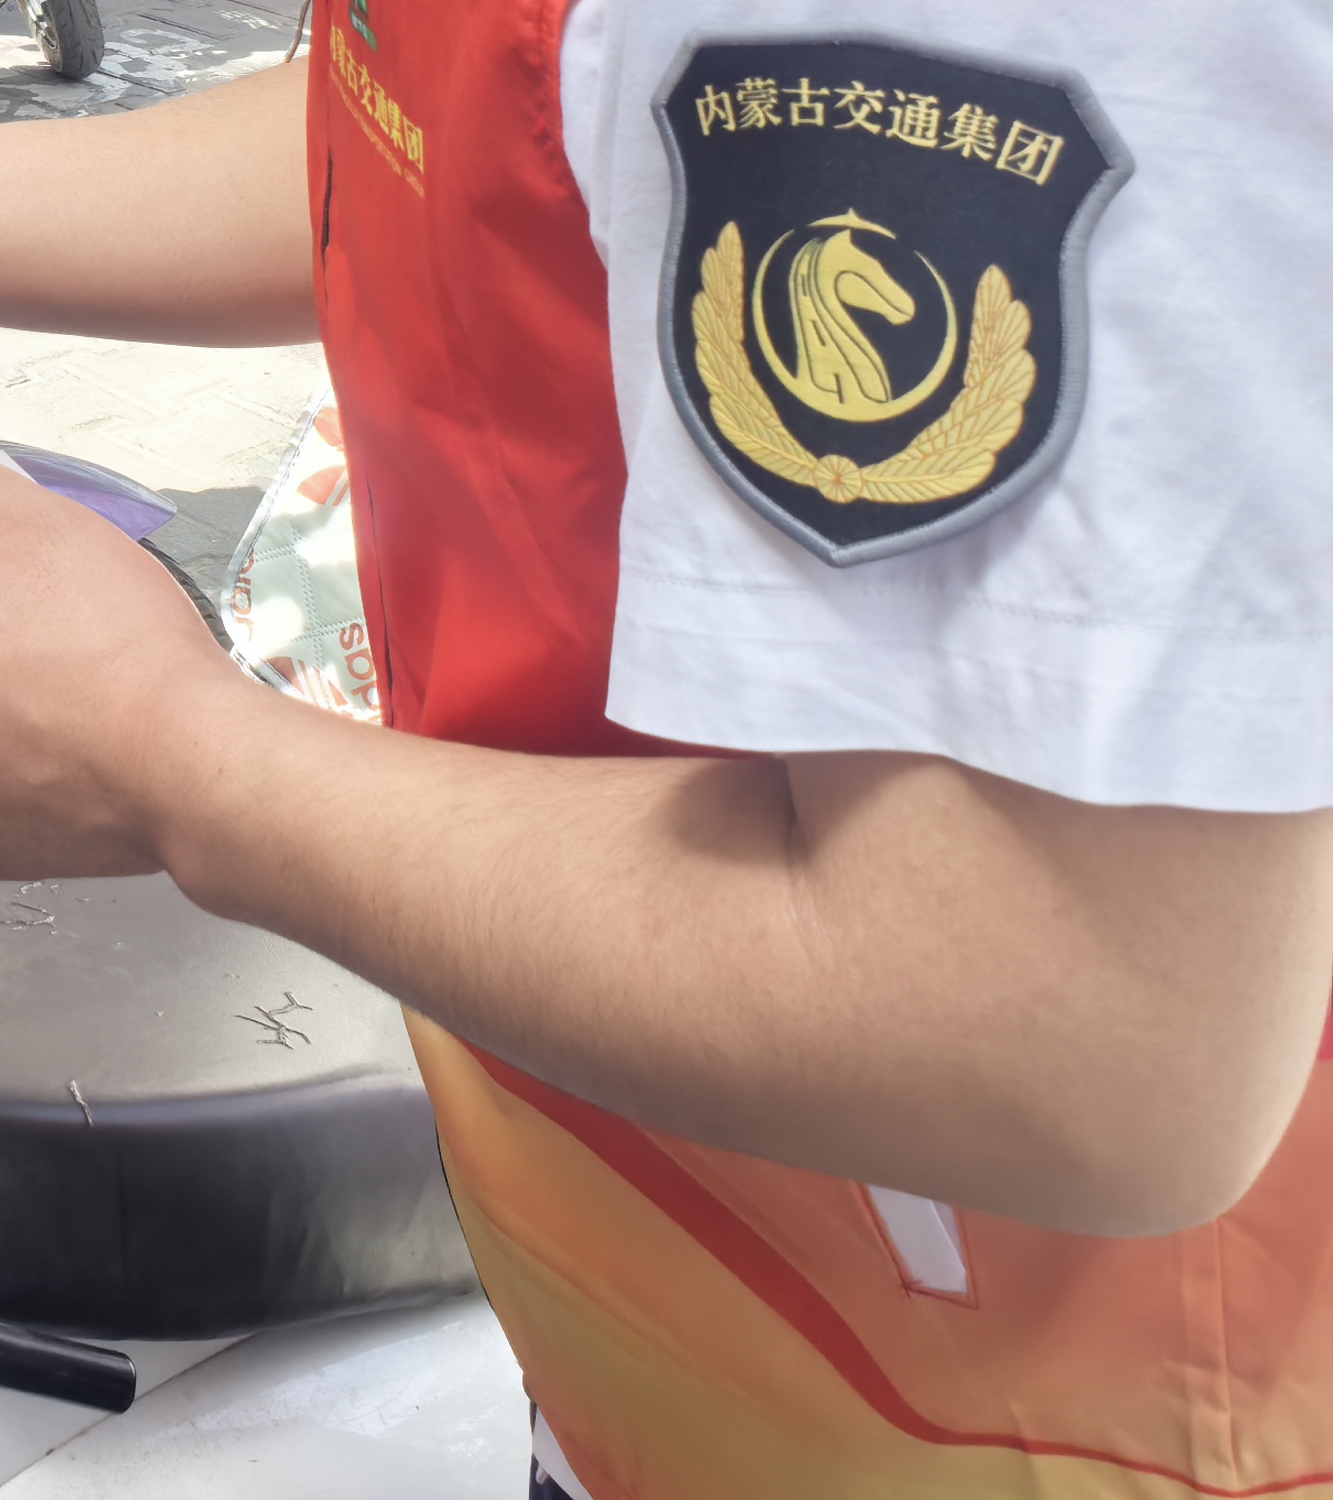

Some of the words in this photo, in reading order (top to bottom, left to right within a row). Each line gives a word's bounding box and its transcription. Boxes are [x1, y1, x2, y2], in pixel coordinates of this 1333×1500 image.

[694, 78, 1066, 186] 内蒙古交通集团
